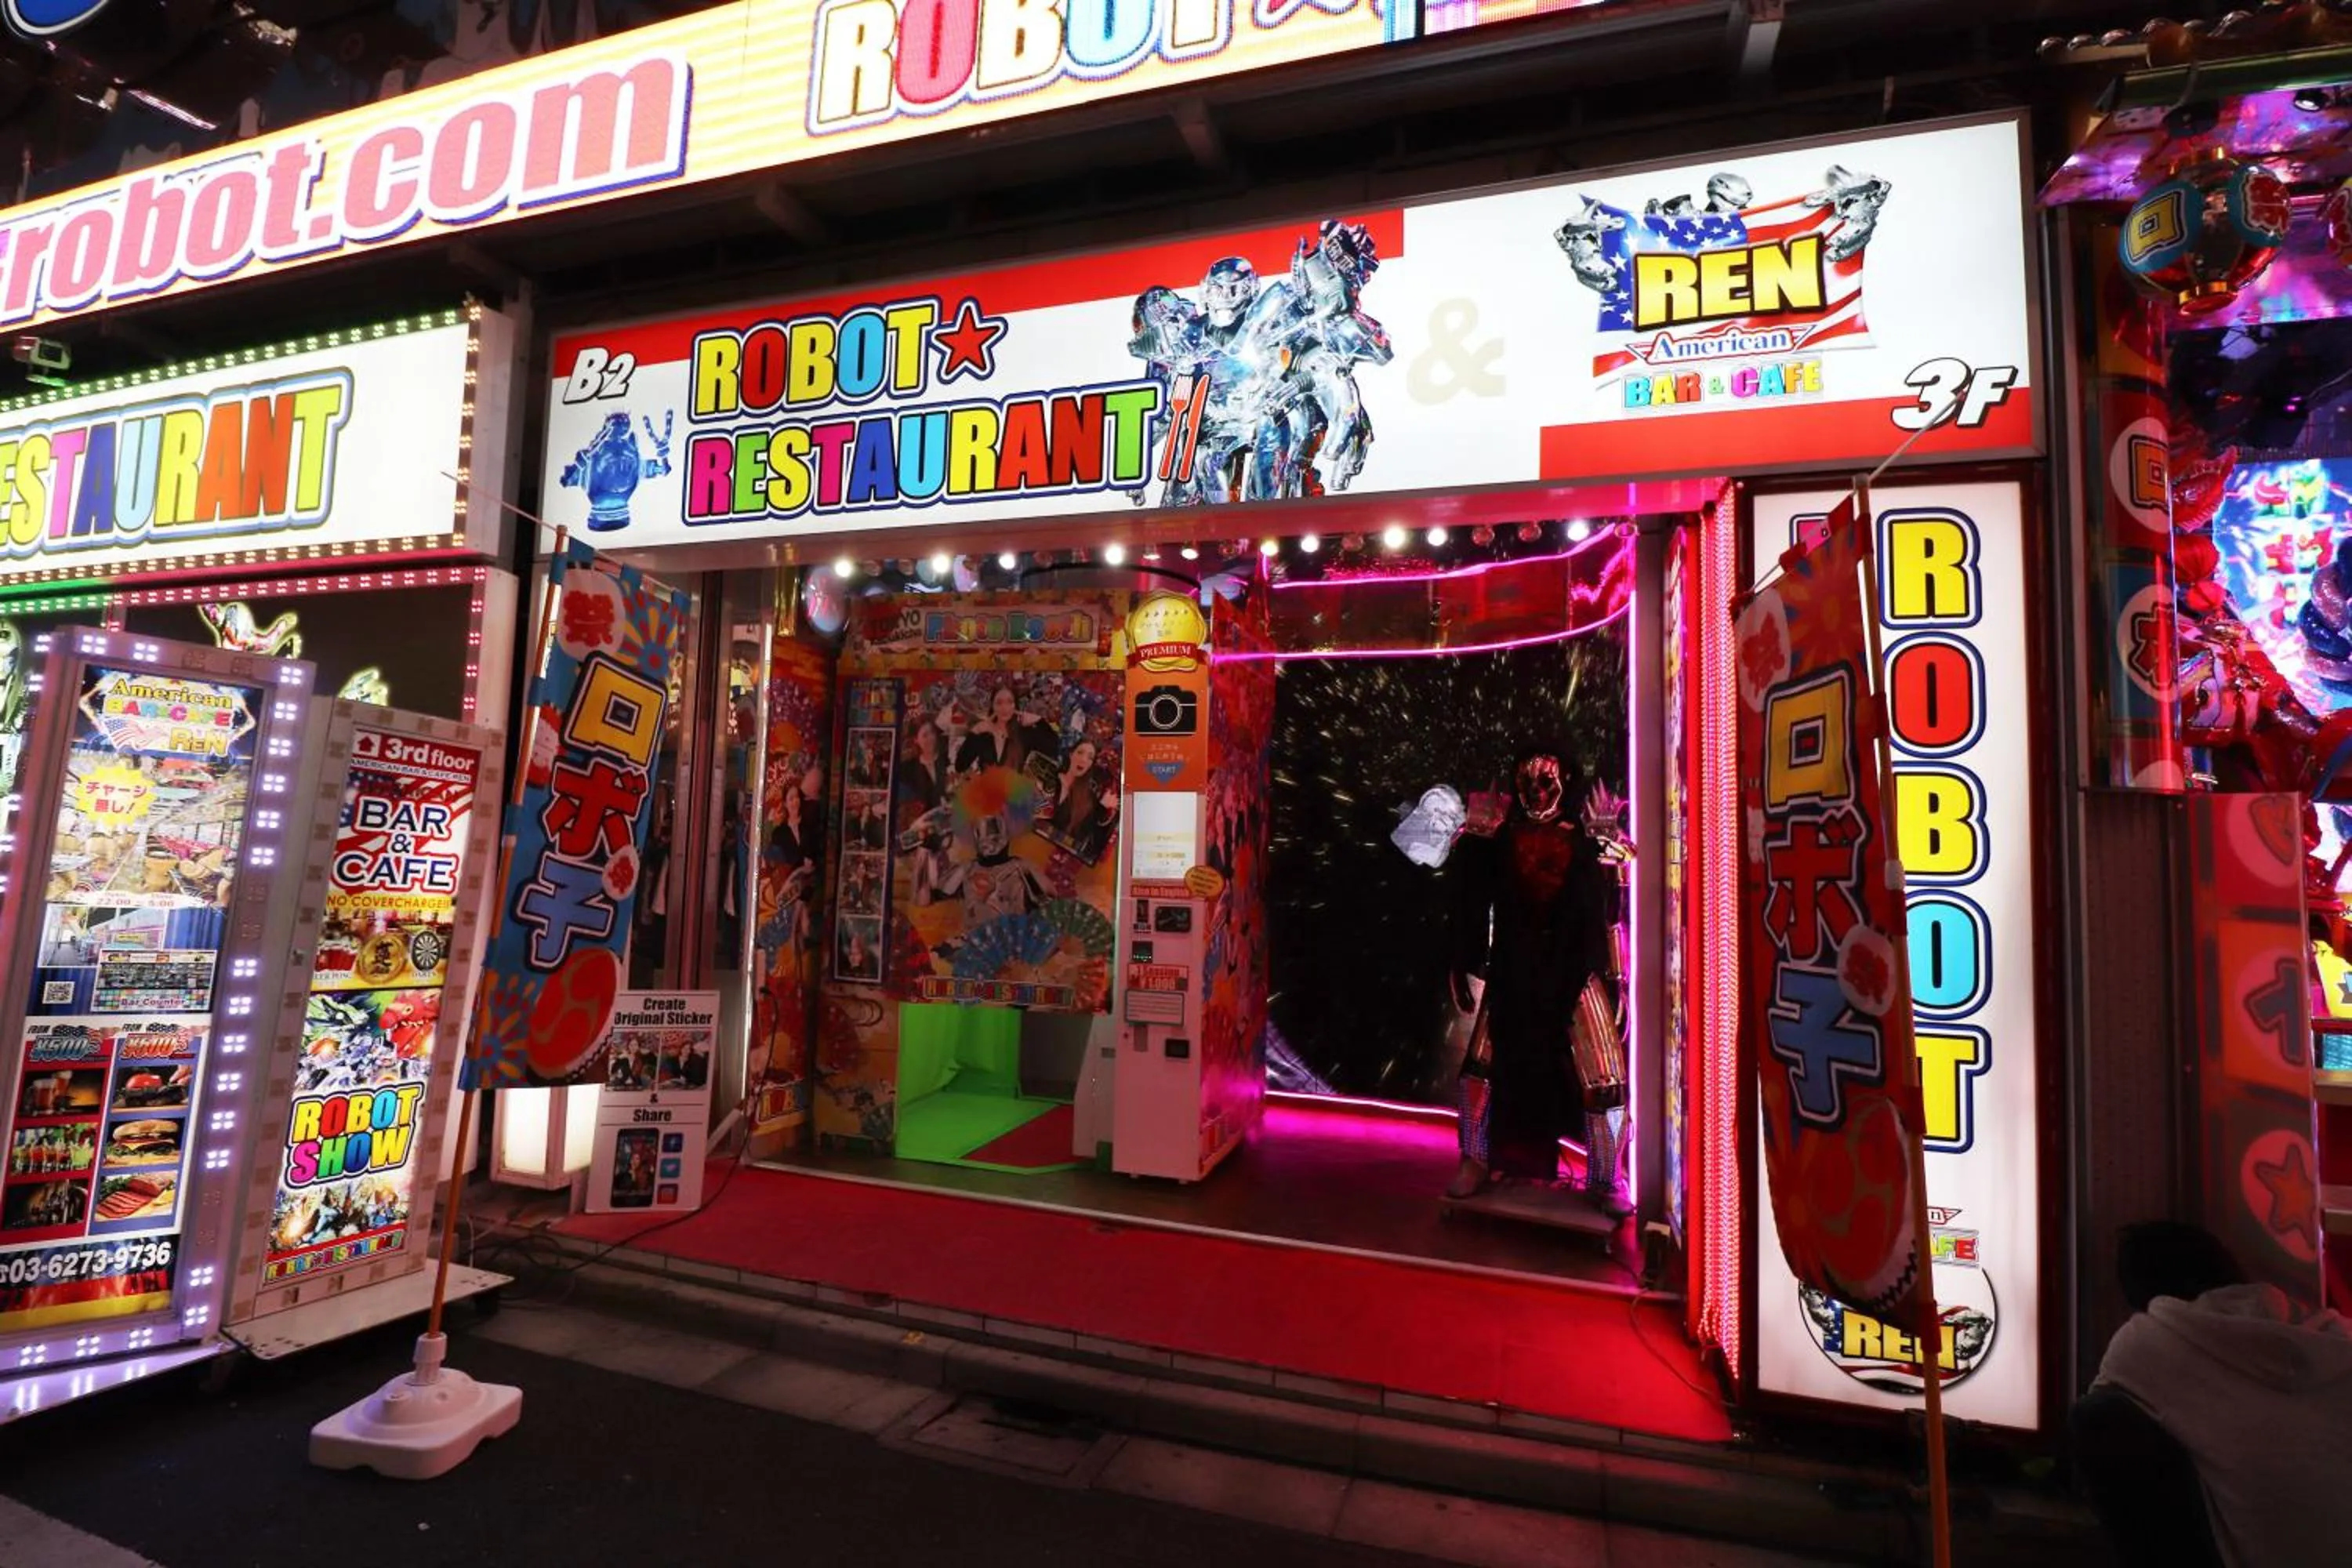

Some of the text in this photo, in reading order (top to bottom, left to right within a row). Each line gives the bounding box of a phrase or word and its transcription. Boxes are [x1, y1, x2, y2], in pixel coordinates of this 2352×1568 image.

[0, 58, 676, 312] robot.com
[1633, 232, 1826, 333] REN
[693, 304, 935, 417] ROBOT
[1406, 296, 1507, 405] &
[1654, 331, 1788, 359] American
[564, 347, 637, 405] B2
[1624, 372, 1702, 408] BAR
[1731, 360, 1823, 397] CAFE
[1890, 356, 2019, 431] 3F
[686, 385, 1160, 519] RESTAURANT
[1139, 644, 1192, 658] PREMIUM
[108, 677, 233, 708] American
[385, 738, 475, 771] 3rd floor
[359, 799, 449, 835] BAR
[1888, 517, 1980, 1142] ROBOT
[391, 833, 412, 854] &
[336, 853, 453, 887] CAFE
[327, 895, 347, 906] NO
[643, 997, 687, 1011] Create
[666, 1012, 713, 1025] Sticker
[292, 1087, 422, 1143] ROBOT
[633, 1109, 673, 1123] Share
[649, 1093, 659, 1103] &
[289, 1126, 411, 1185] SHOW
